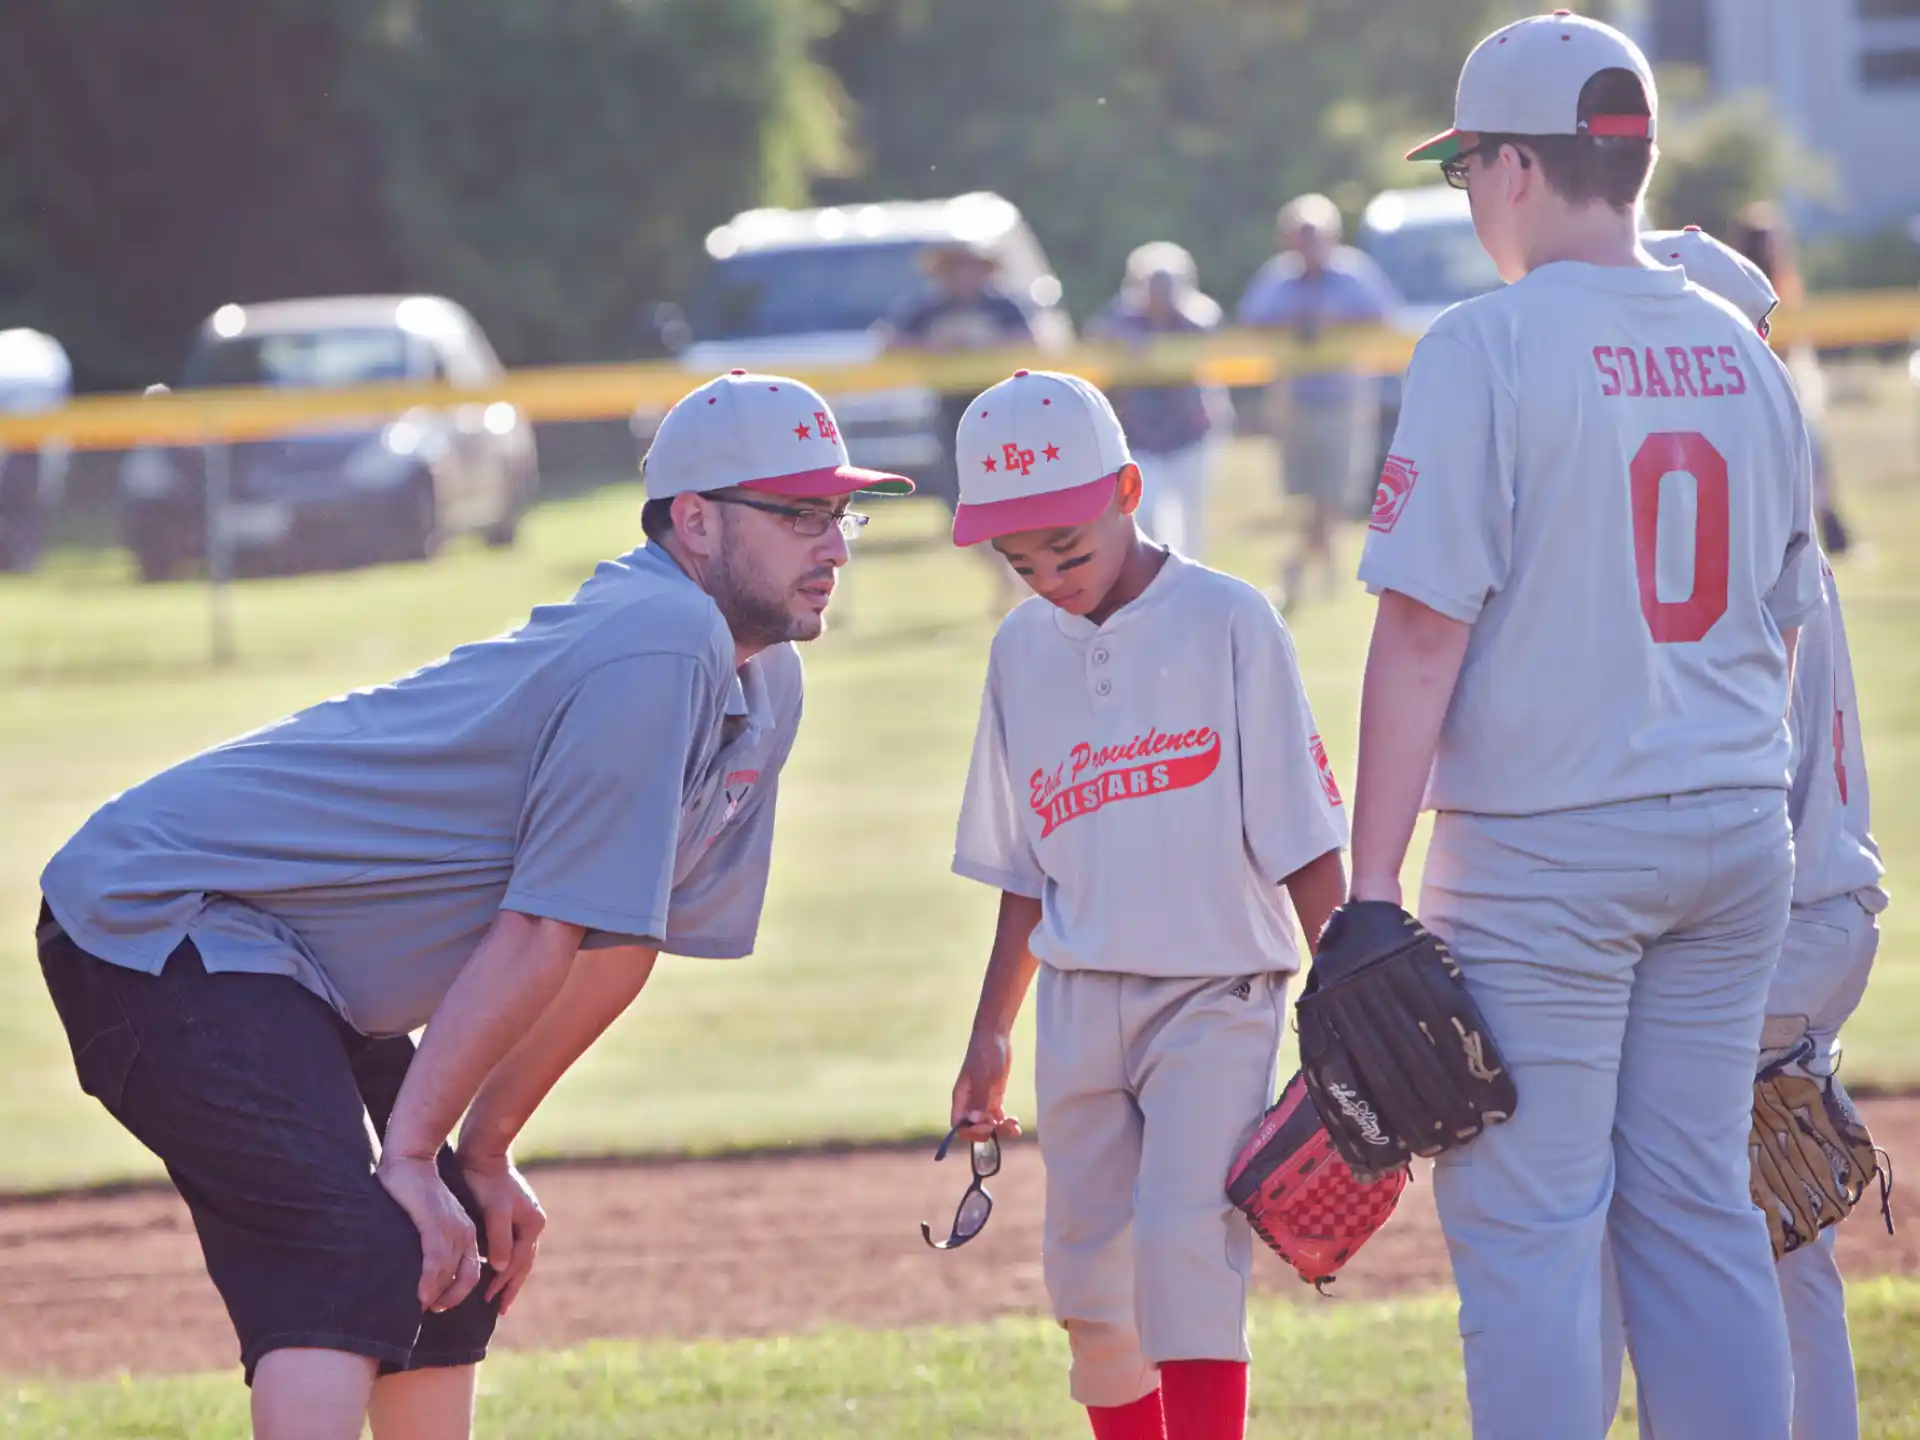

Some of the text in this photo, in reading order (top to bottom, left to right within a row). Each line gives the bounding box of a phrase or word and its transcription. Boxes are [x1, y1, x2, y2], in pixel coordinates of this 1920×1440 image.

[1592, 345, 1746, 397] SOARES
[1629, 431, 1730, 643] 0
[1069, 726, 1211, 783] Providence
